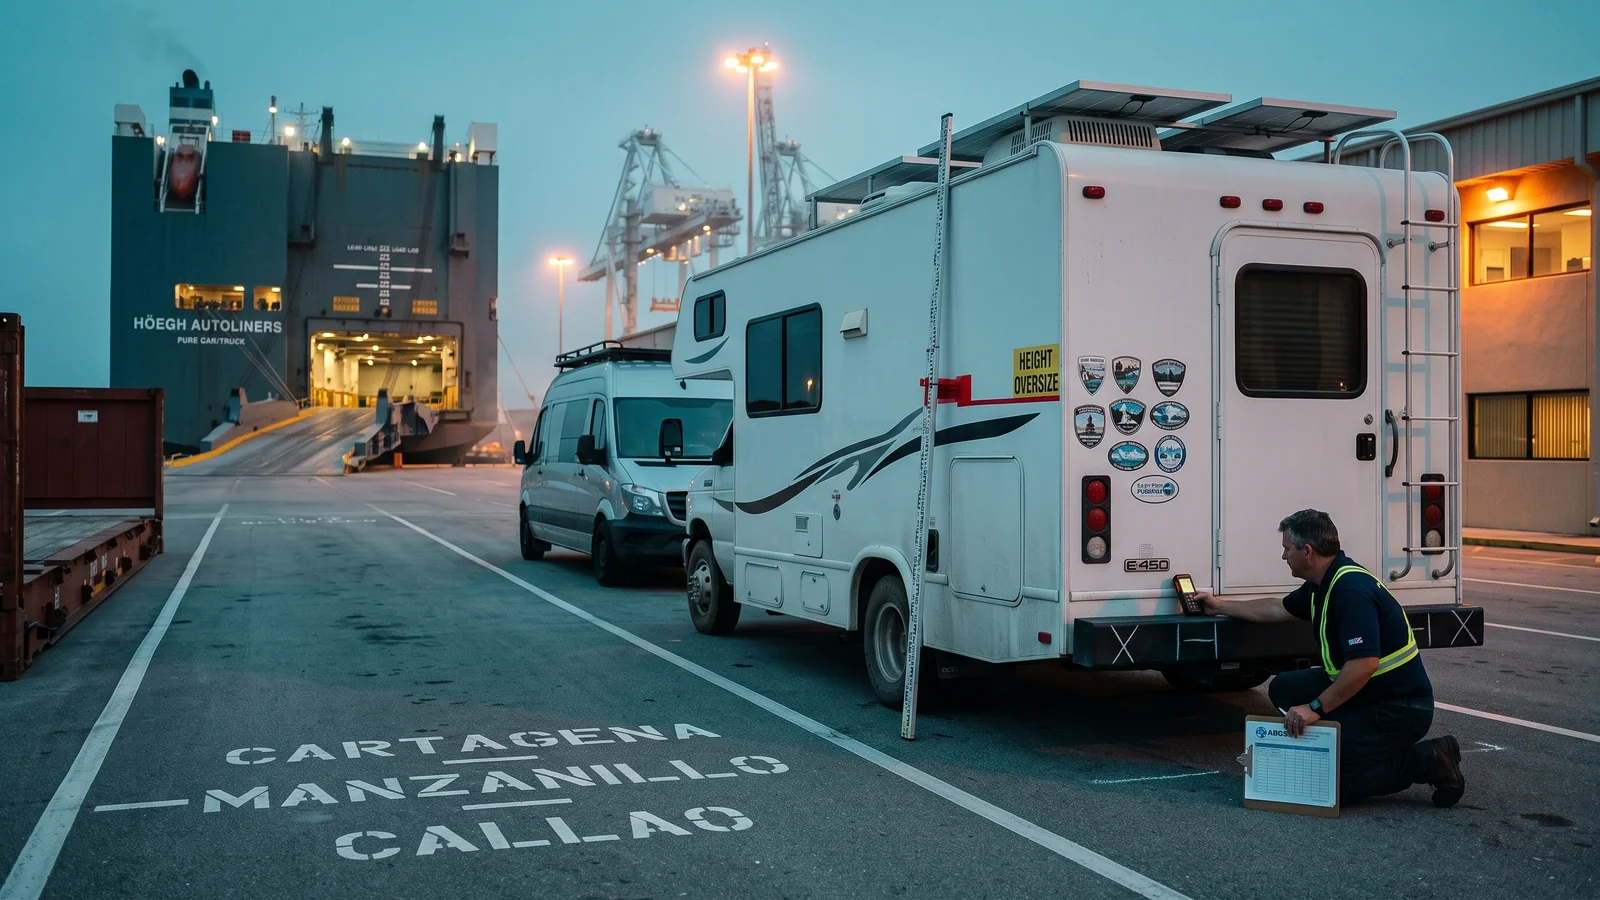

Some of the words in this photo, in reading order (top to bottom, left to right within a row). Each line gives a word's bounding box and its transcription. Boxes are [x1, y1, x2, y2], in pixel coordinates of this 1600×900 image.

[134, 315, 186, 331] HÖEGH
[191, 318, 283, 333] AUTOLINERS
[177, 336, 198, 344] PURE
[200, 336, 246, 345] CAR/TRUCK
[1019, 348, 1053, 371] HEIGHT
[1014, 372, 1059, 395] OVERSIZE
[226, 723, 722, 765] CARTAGENA
[203, 755, 790, 813] MANZANILLO
[335, 806, 754, 860] CALLAO
